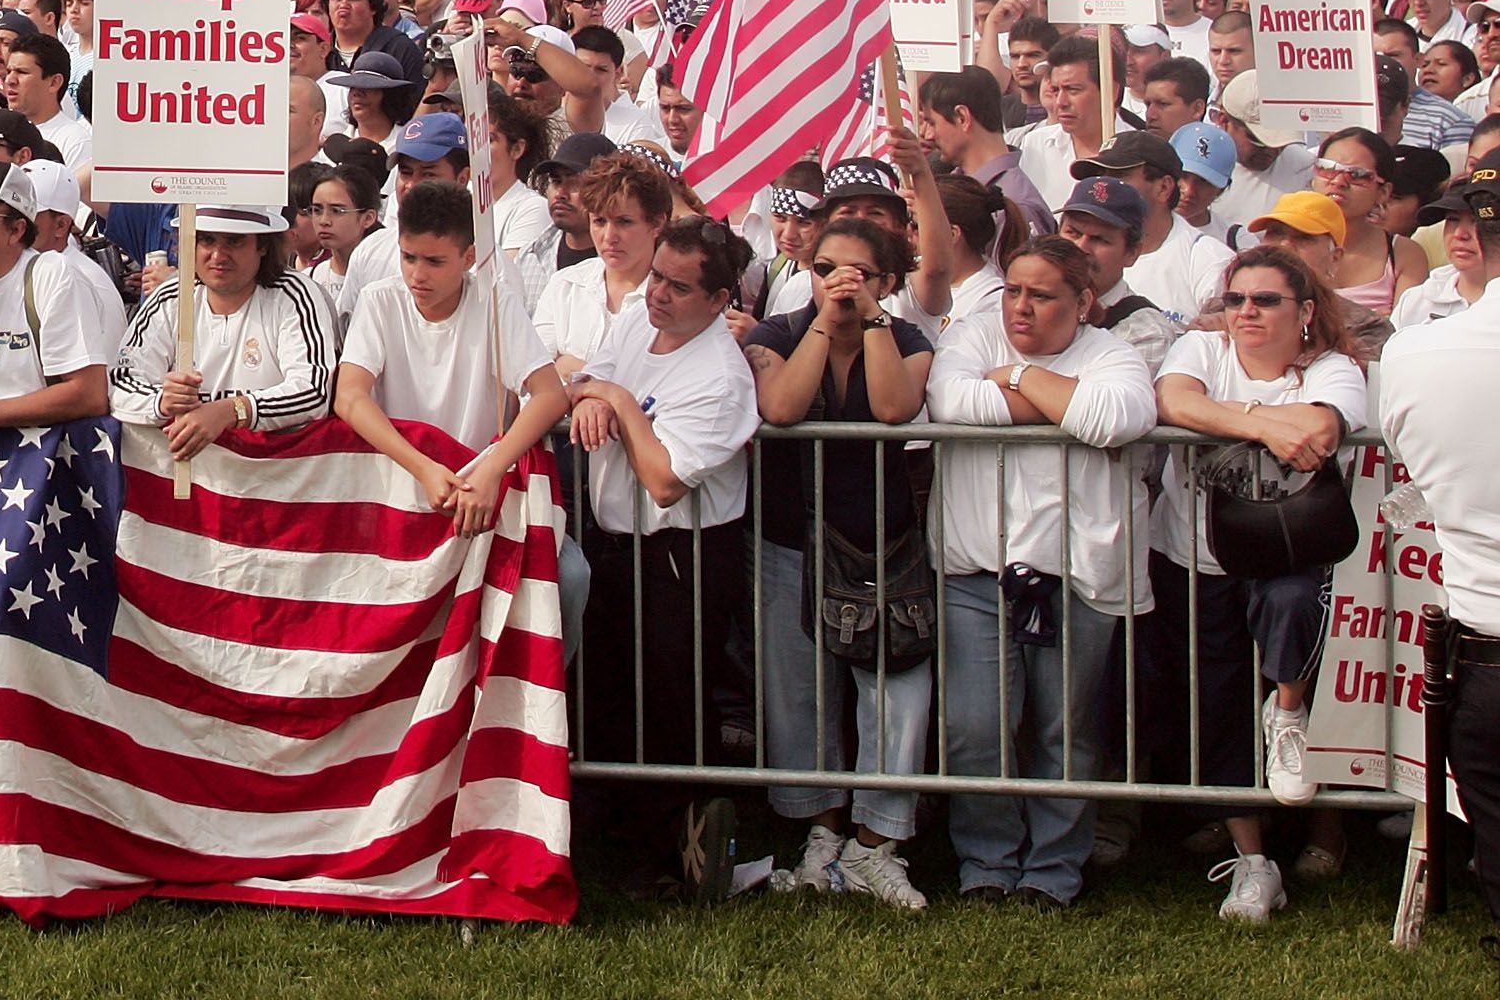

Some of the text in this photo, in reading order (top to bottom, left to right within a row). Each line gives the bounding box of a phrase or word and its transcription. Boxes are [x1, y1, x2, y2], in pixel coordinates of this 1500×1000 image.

[1258, 2, 1365, 33] American
[98, 19, 285, 64] Families
[1277, 41, 1354, 70] Dream
[116, 81, 266, 125] United
[170, 176, 228, 186] THE COUNCIL
[1367, 531, 1443, 587] Kee
[1330, 594, 1425, 648] Fami
[1334, 660, 1424, 714] Unit
